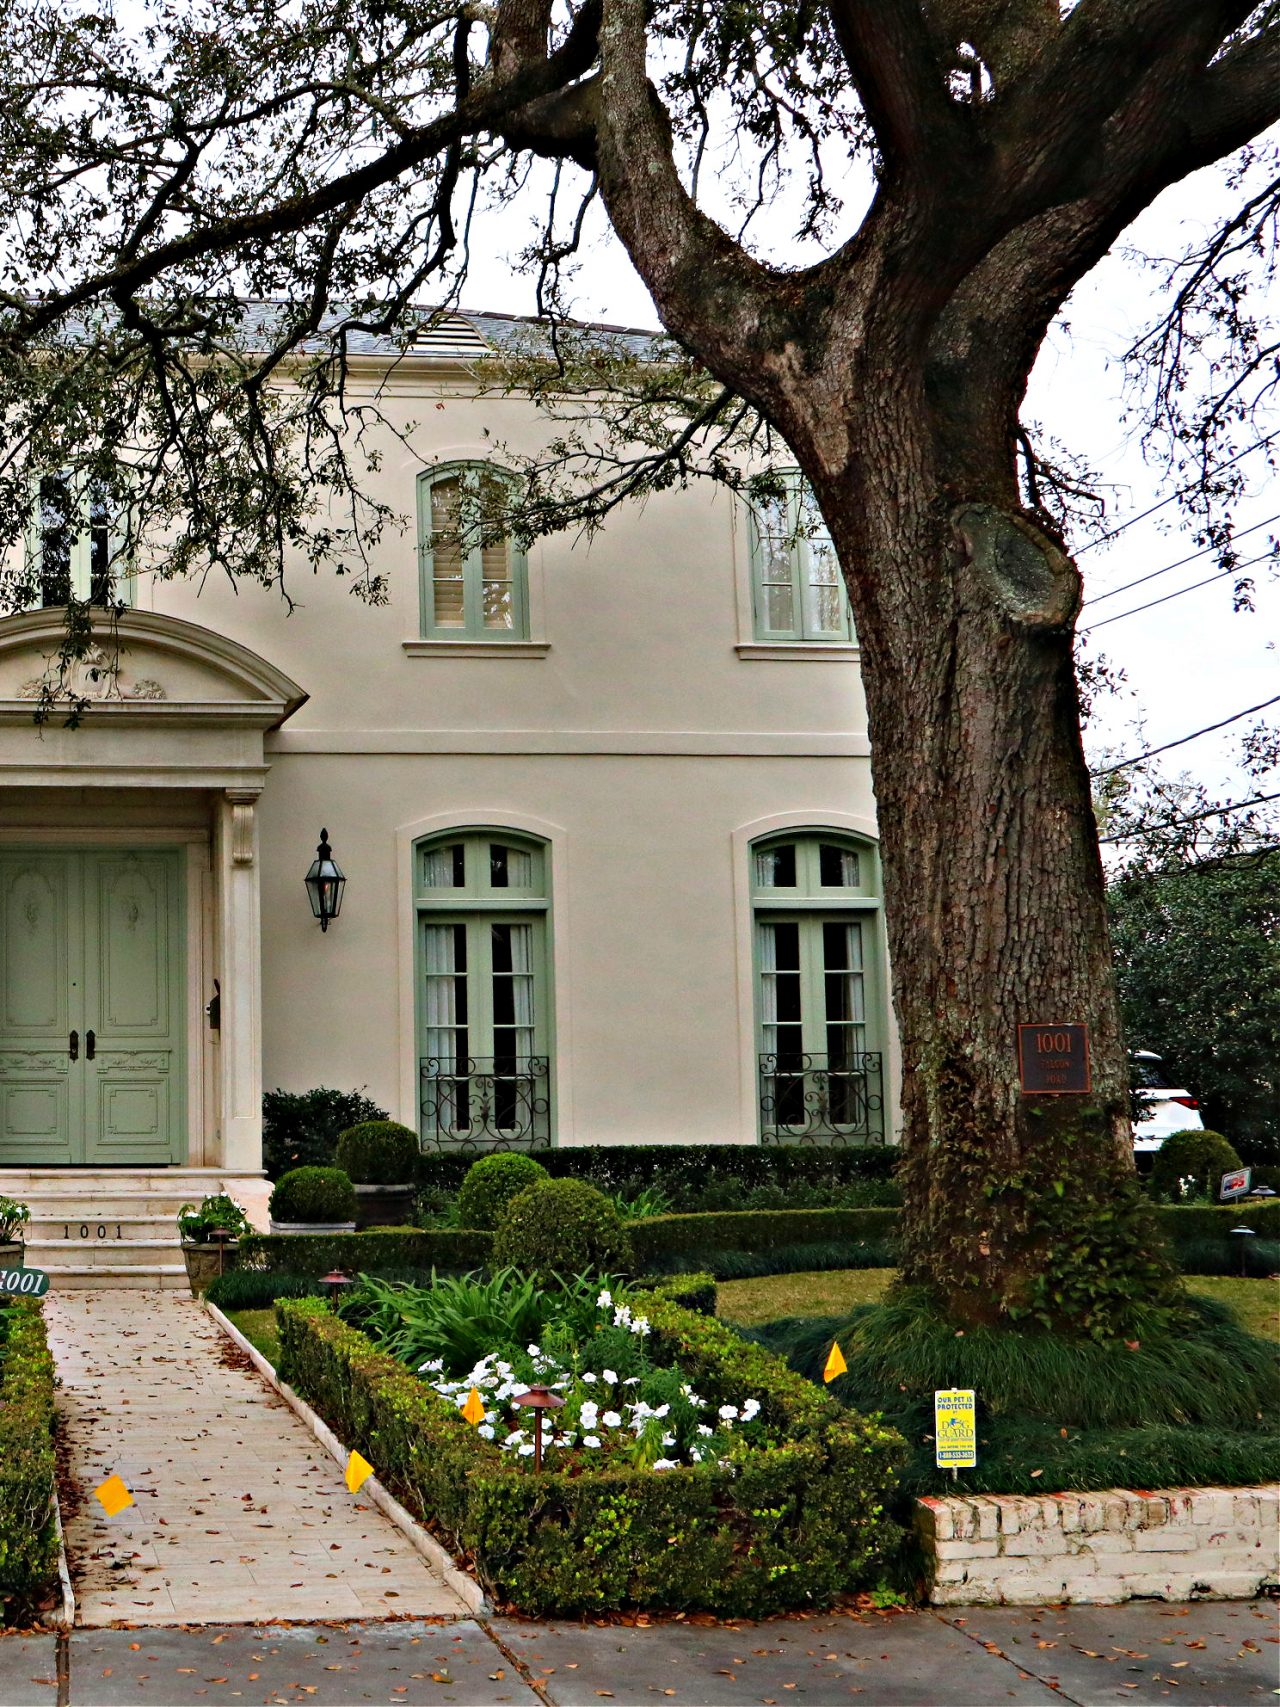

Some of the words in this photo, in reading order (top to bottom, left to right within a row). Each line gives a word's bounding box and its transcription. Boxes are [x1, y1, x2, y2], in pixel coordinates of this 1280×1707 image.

[1036, 1033, 1072, 1053] 1001
[63, 1225, 122, 1239] 1001
[942, 1419, 970, 1430] DOG
[938, 1429, 973, 1437] GUARD
